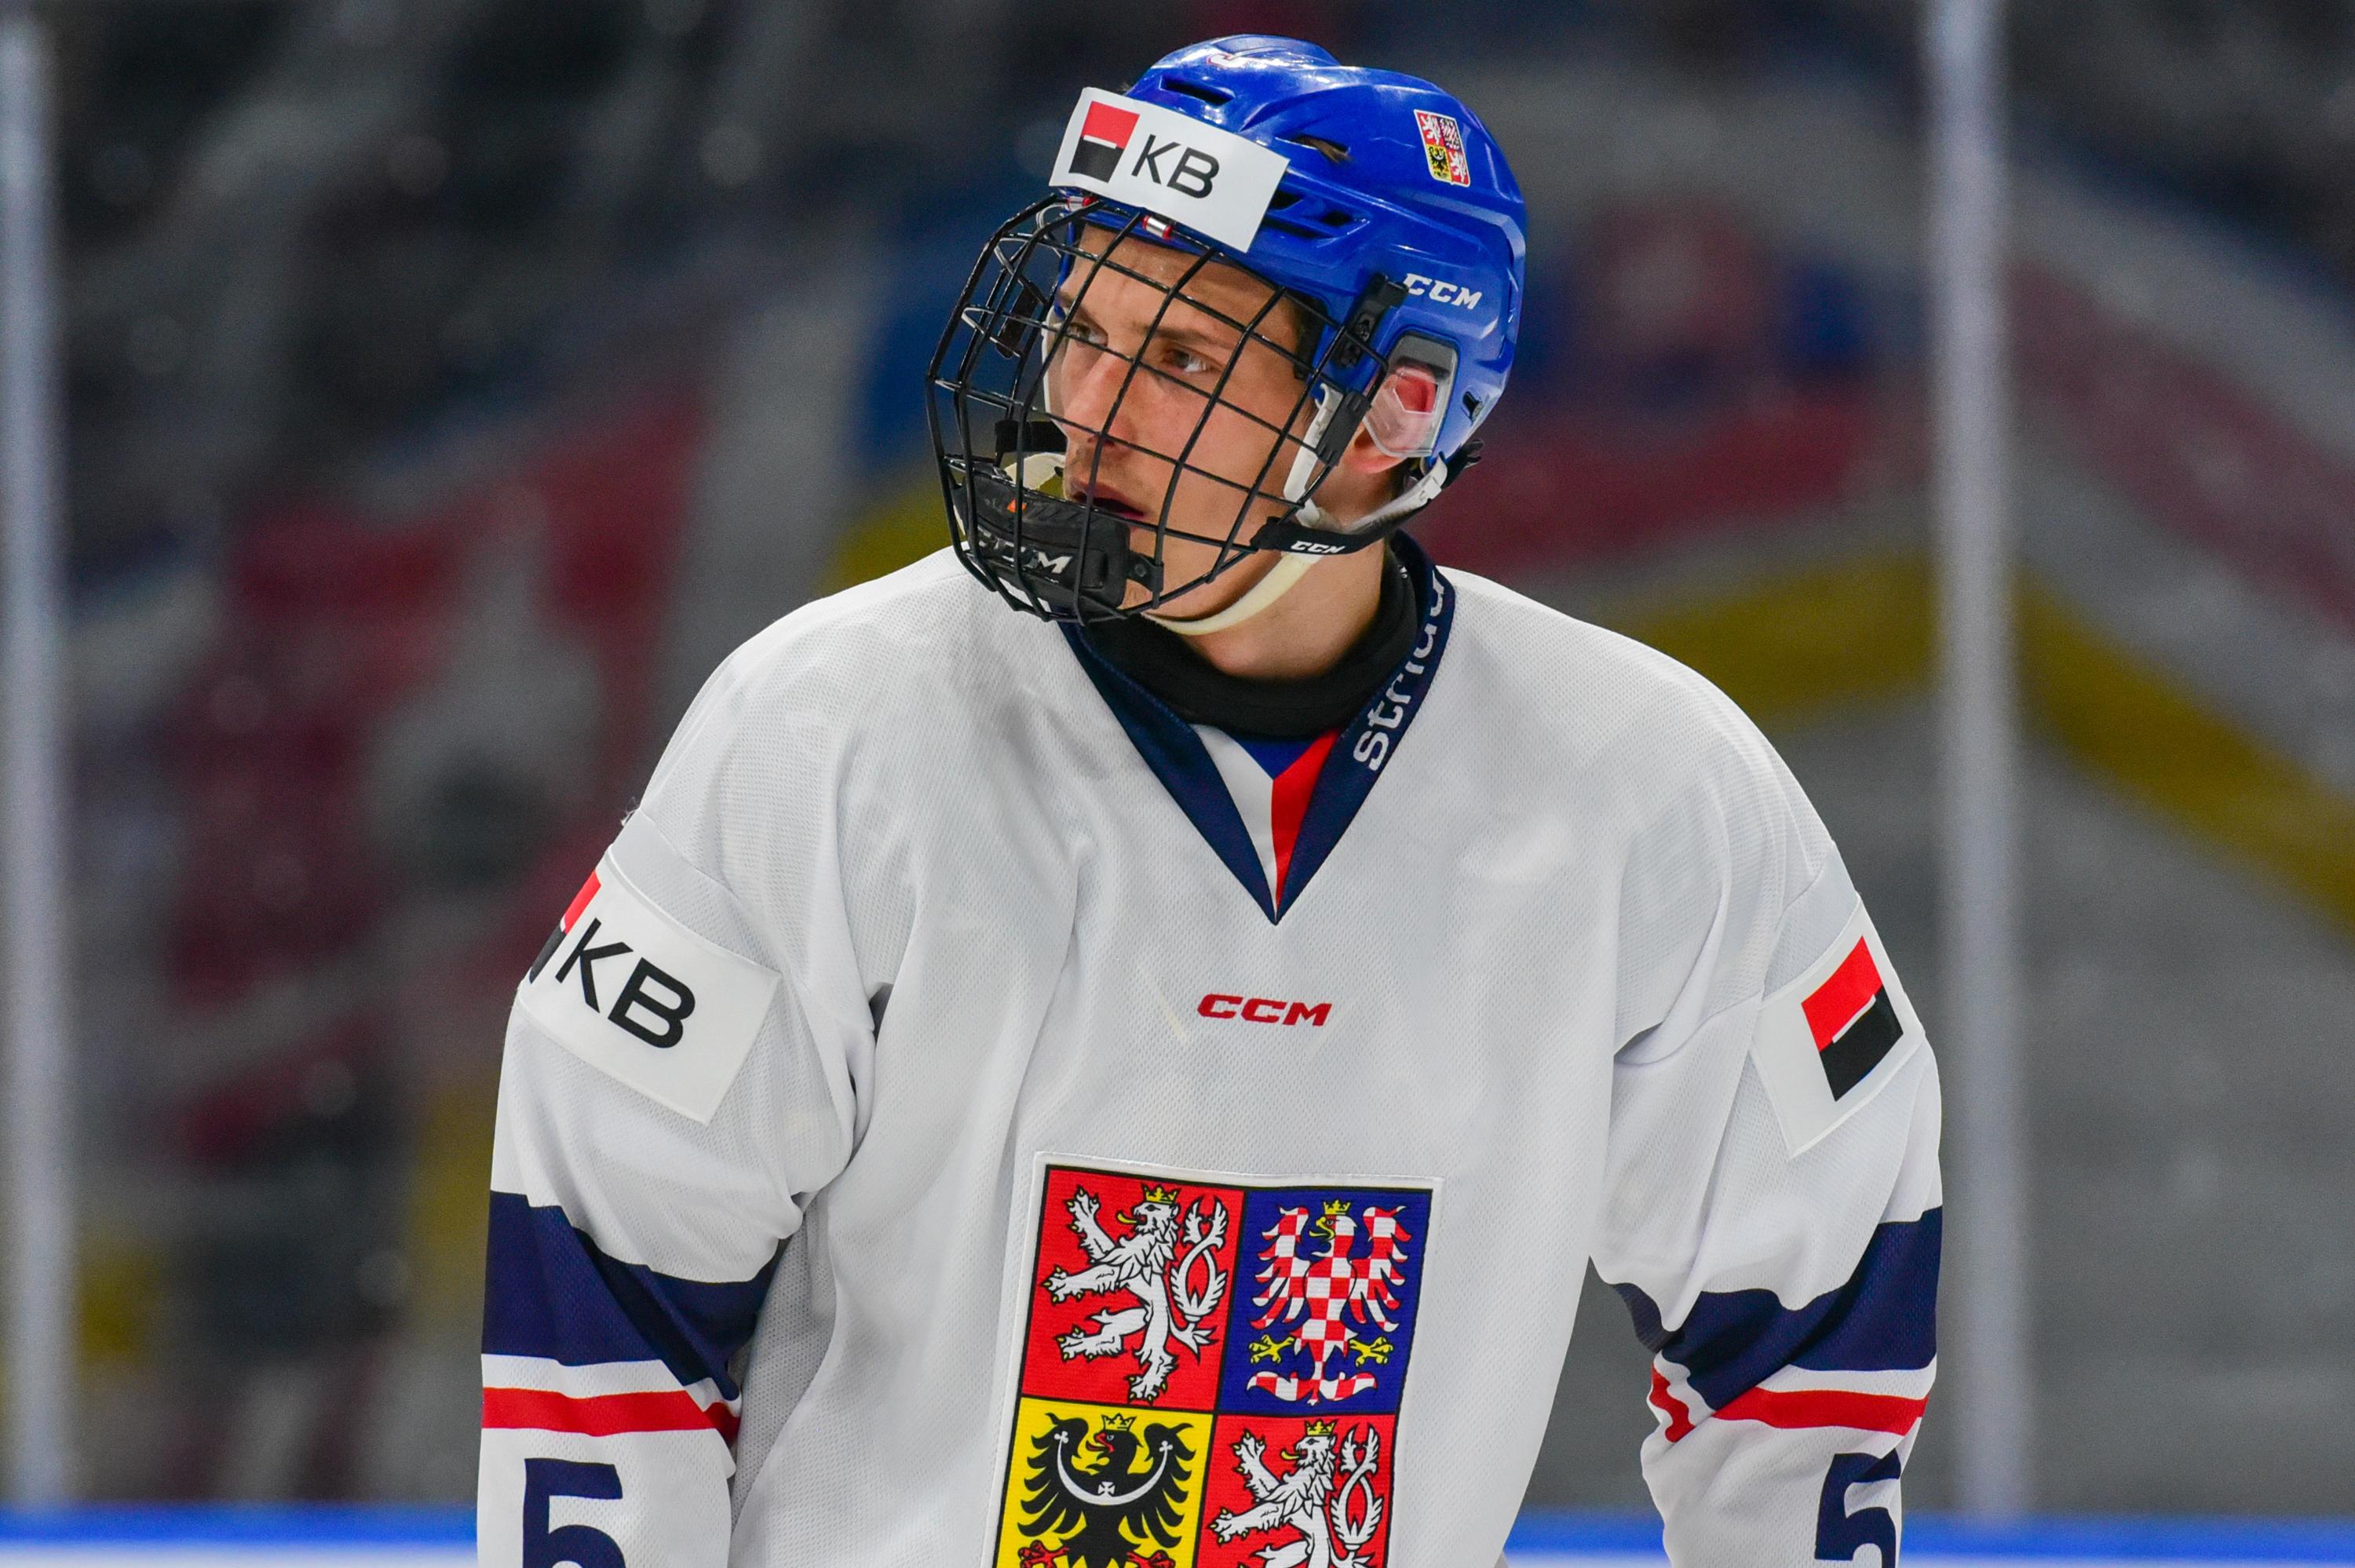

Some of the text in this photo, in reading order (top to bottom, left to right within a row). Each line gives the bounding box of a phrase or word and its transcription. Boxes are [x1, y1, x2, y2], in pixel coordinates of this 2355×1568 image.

[1131, 133, 1219, 199] KB
[1403, 273, 1483, 310] CCM
[555, 917, 696, 1049] KB
[1197, 994, 1332, 1026] CCM
[522, 1458, 626, 1568] 5
